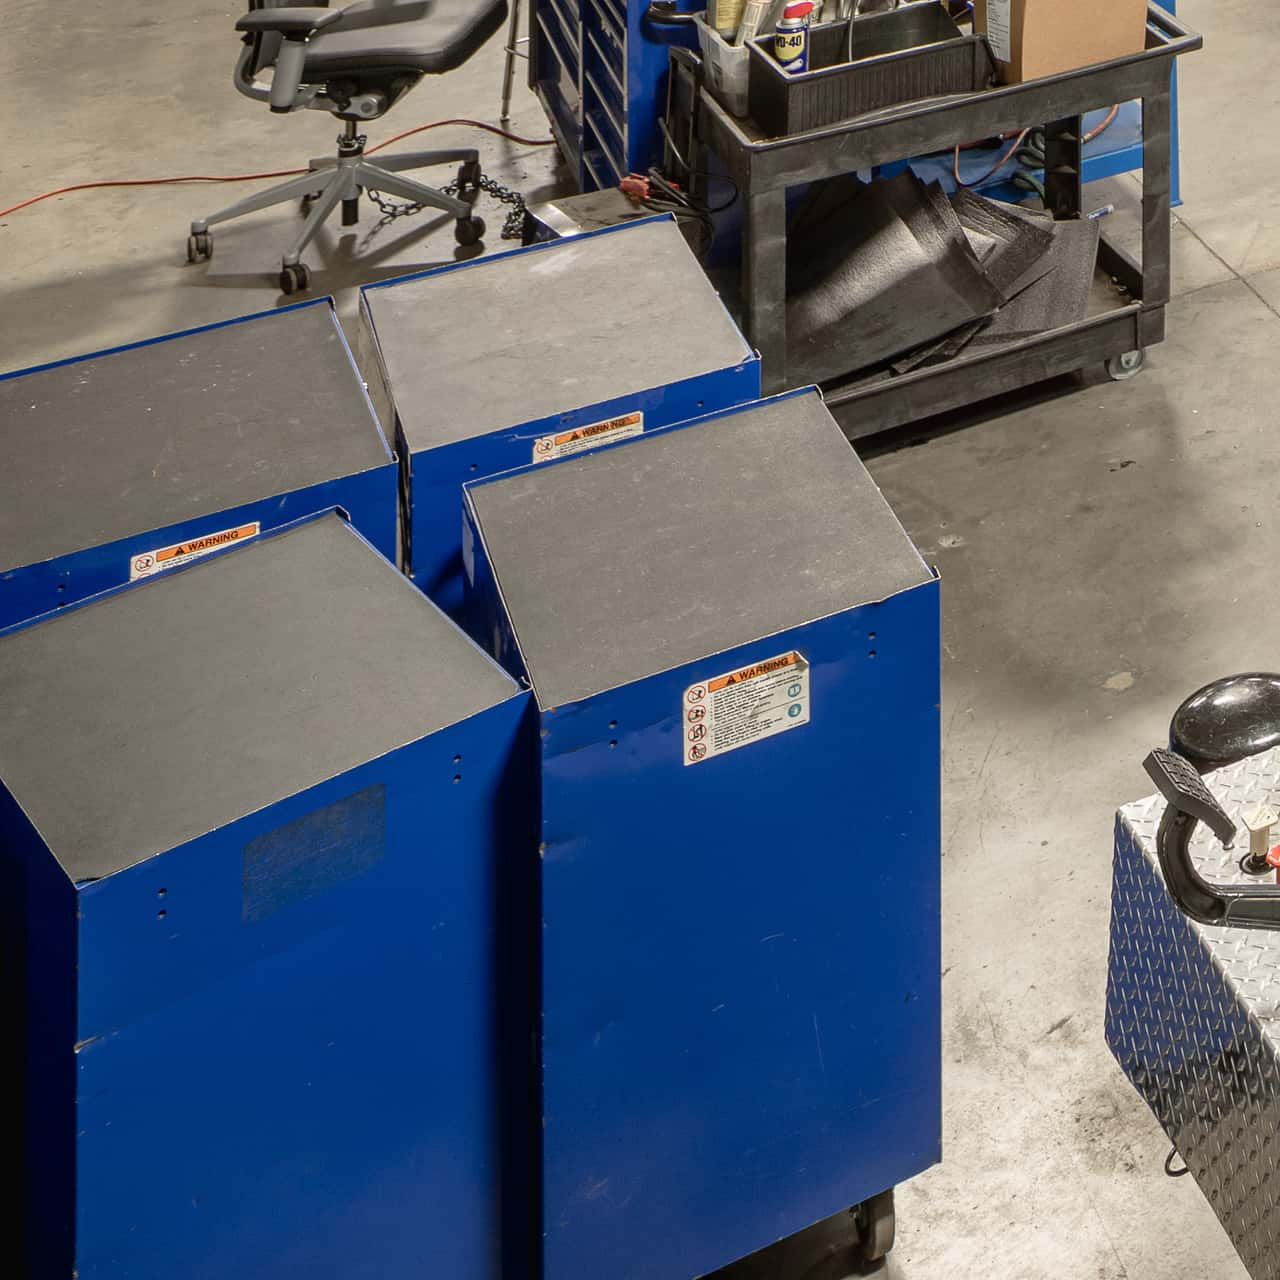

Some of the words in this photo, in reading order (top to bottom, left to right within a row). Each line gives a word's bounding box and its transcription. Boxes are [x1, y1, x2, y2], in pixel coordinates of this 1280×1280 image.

[582, 418, 626, 437] WARNING
[187, 530, 239, 552] WARNING
[738, 657, 789, 680] WARNING
